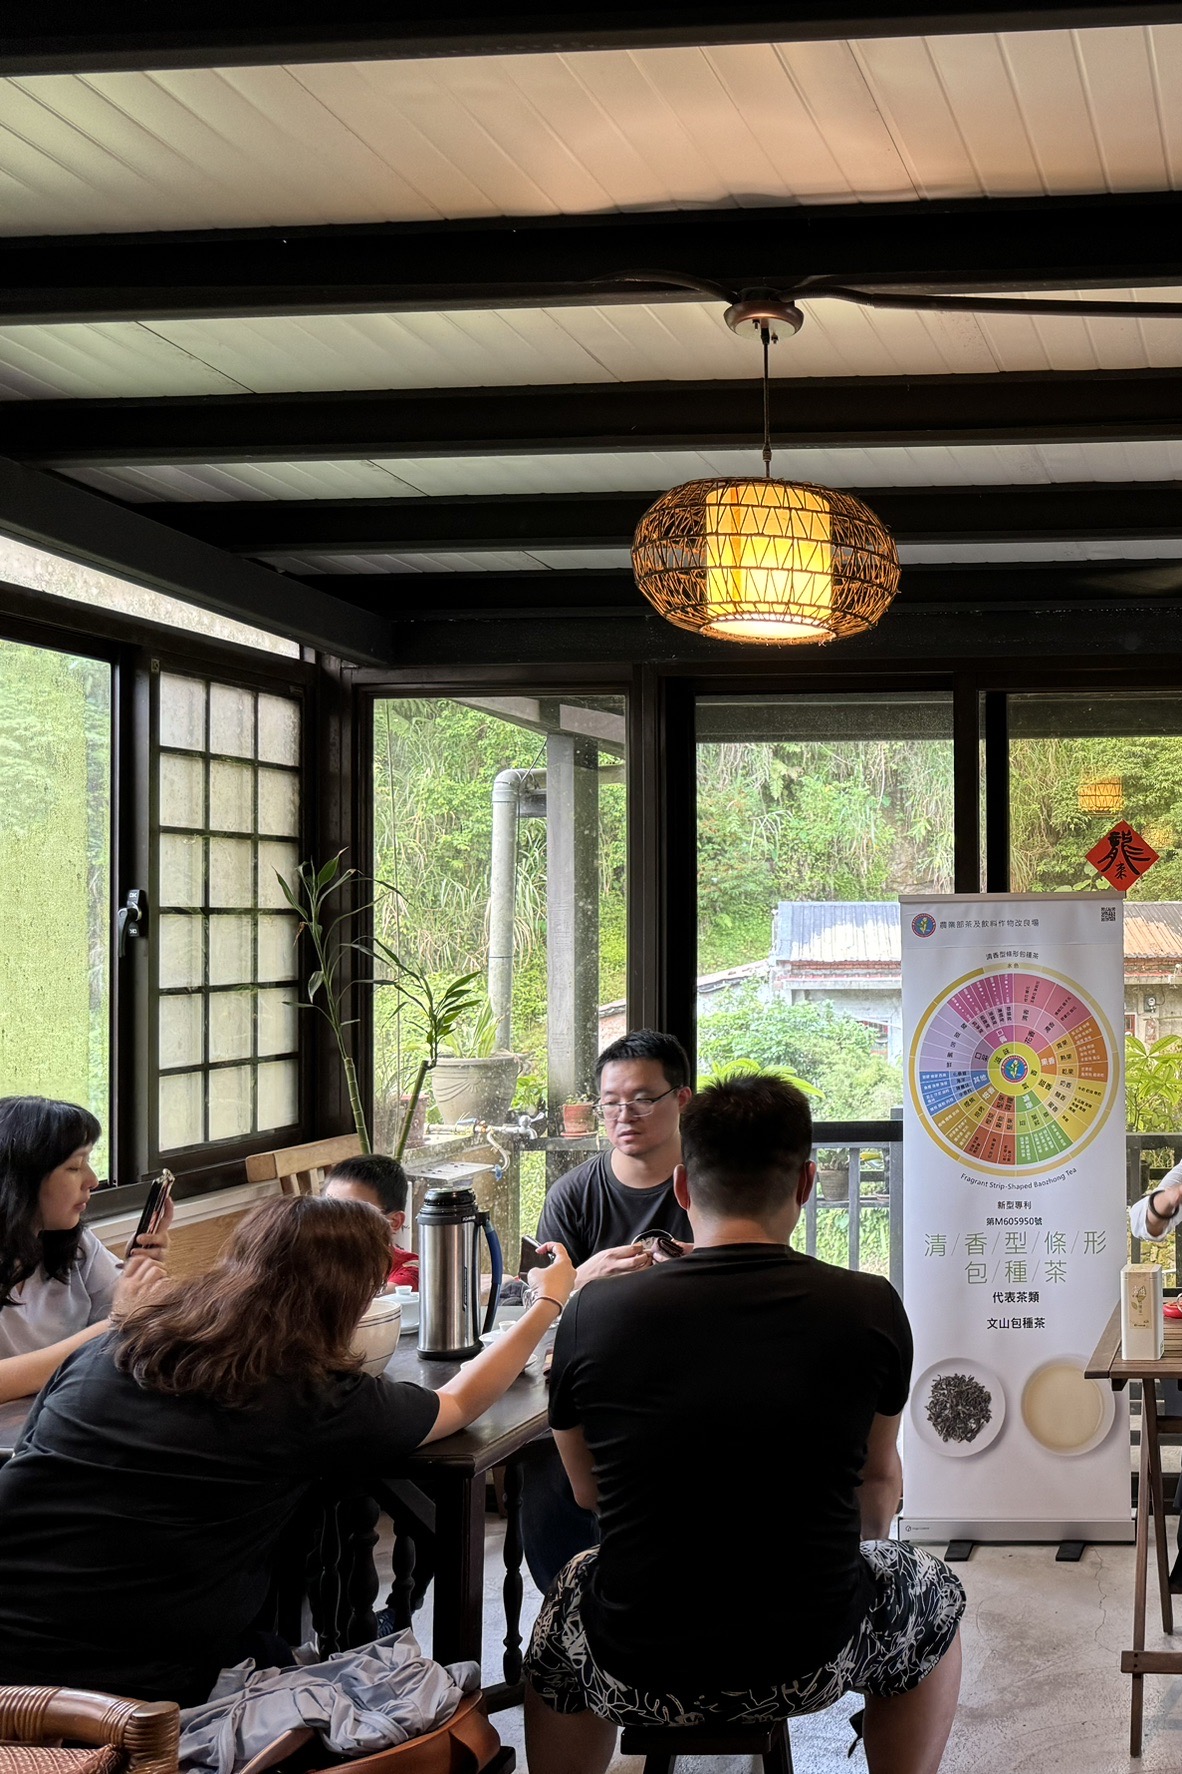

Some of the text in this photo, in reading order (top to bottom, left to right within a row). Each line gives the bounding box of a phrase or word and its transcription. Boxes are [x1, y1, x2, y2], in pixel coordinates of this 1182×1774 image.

[973, 1074, 987, 1084] 其他
[960, 1167, 1077, 1190] Fragrant Strip-Shaped Baozhong Tea
[997, 1201, 1032, 1209] 新型專利
[986, 1217, 1043, 1226] 第M605950號
[992, 1291, 1040, 1304] 代表茶類
[987, 1317, 1046, 1330] 文山包種茶
